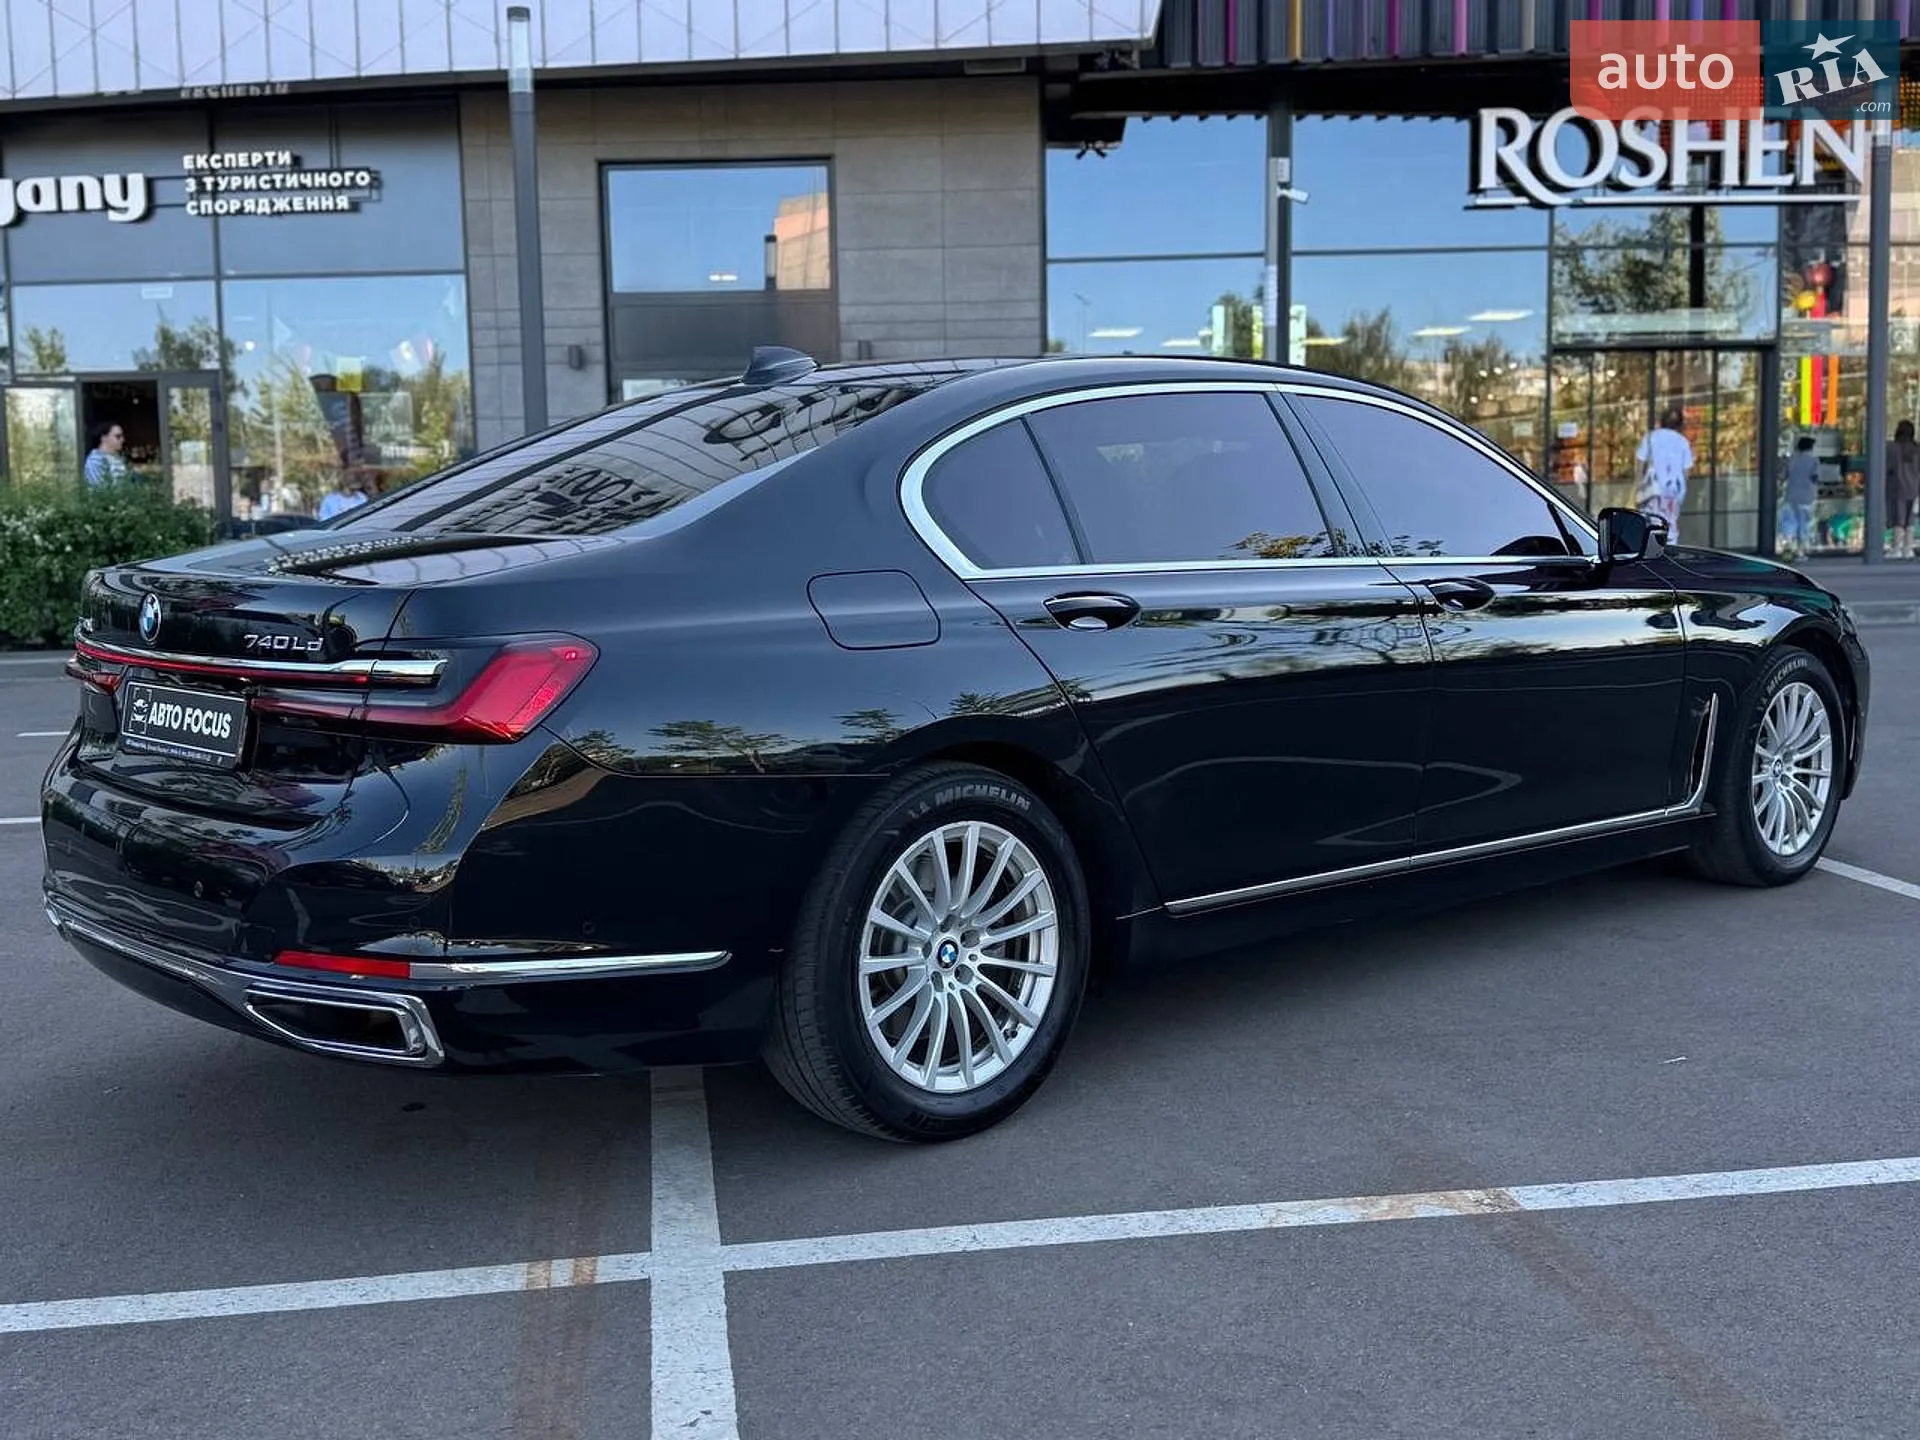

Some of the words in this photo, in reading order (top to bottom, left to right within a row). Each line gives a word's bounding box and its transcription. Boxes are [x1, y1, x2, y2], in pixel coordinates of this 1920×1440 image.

[182, 150, 292, 170] ЕКСПЕРТИ
[1477, 106, 1865, 206] ROSHEN
[203, 170, 371, 193] ТУРИСТИЧНОГО
[185, 194, 350, 216] СПОРЯДЖЕННЯ
[243, 634, 325, 652] 740Ld
[182, 706, 233, 739] FOCUS
[934, 784, 1032, 811] MICHELIN
